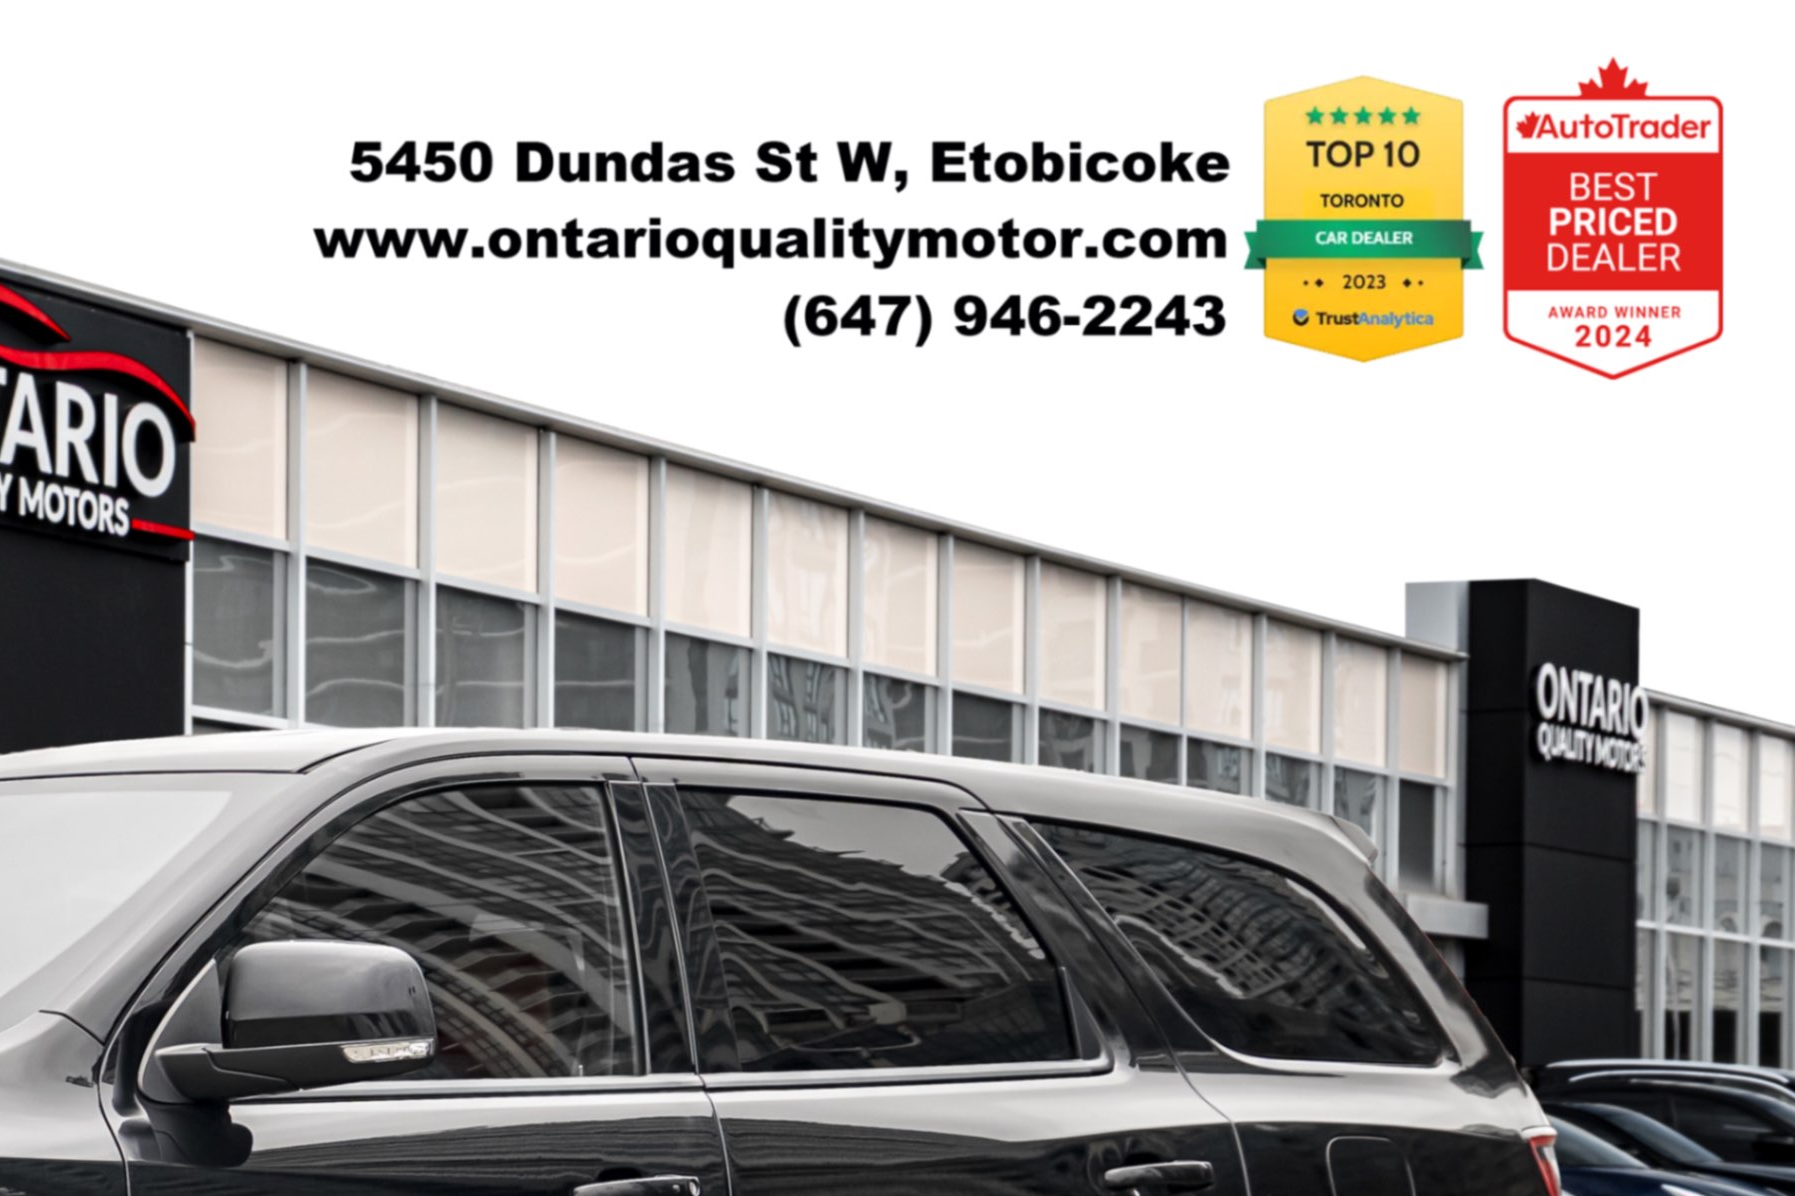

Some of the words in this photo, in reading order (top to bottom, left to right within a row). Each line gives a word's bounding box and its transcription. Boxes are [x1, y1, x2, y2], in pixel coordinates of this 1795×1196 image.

[18, 476, 131, 537] MOTORS
[1537, 661, 1649, 739] ONTARIO
[1537, 721, 1594, 763] QUALITY
